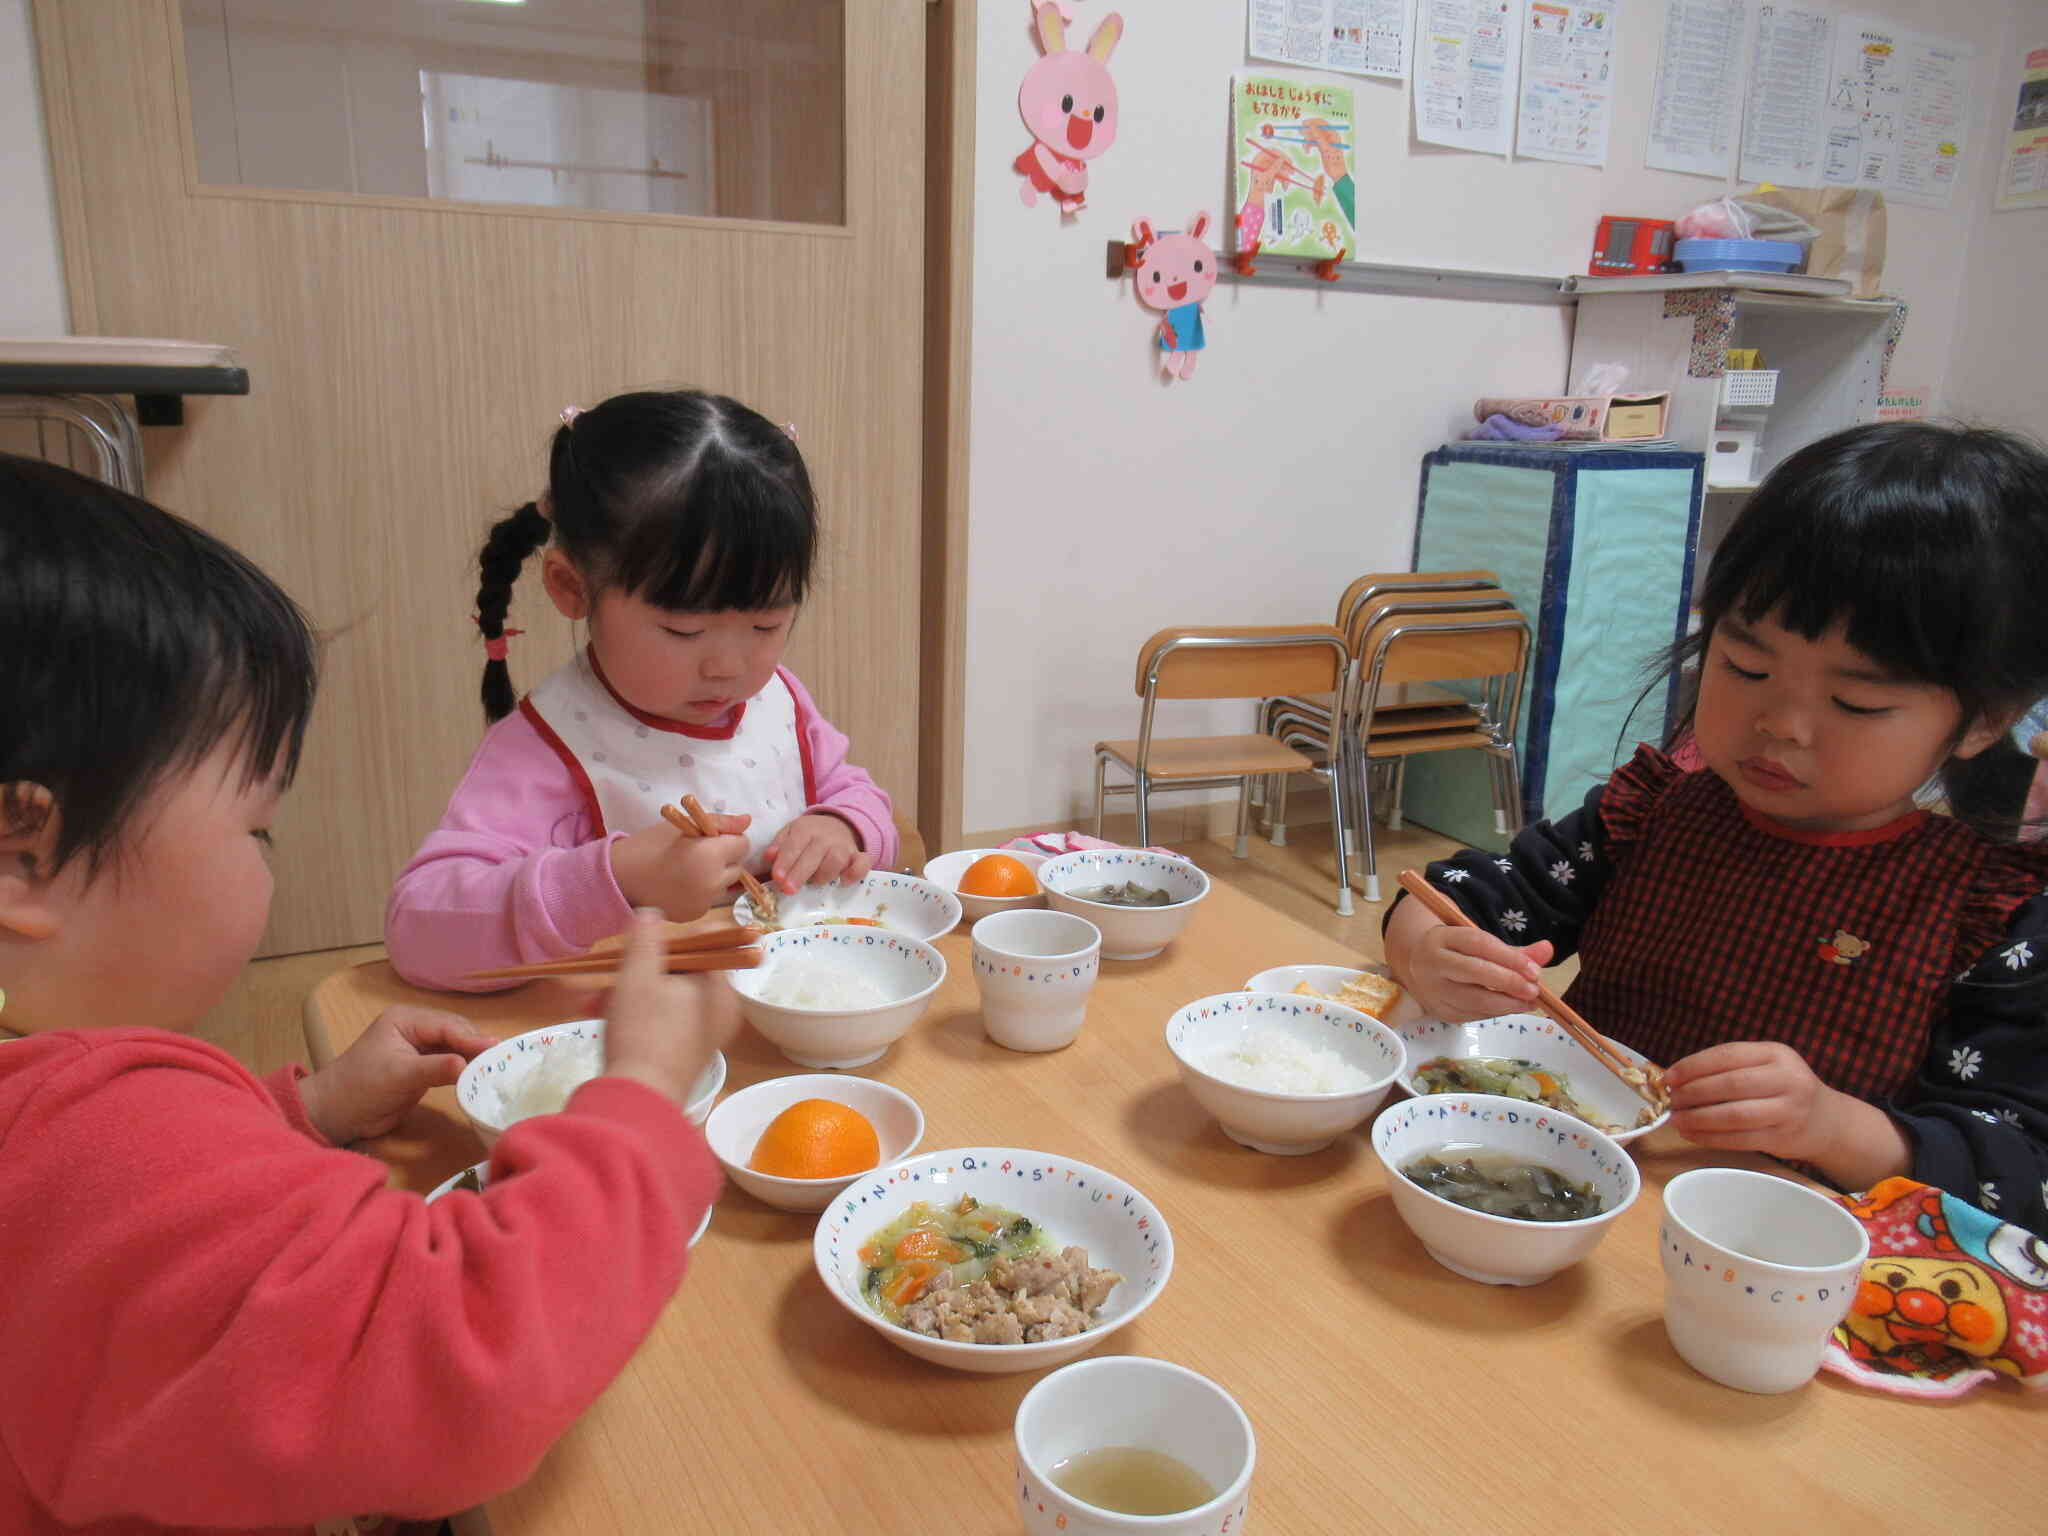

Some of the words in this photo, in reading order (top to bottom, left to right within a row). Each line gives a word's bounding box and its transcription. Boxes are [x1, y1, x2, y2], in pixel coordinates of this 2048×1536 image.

[1246, 82, 1284, 99] おはしを
[1288, 87, 1334, 106] じょうずに
[1252, 101, 1302, 119] もてるかな
[1354, 1021, 1364, 1034] D
[516, 1039, 525, 1052] V
[541, 1035, 554, 1049] W
[1459, 1102, 1470, 1113] B
[1481, 1111, 1491, 1122] C
[1507, 1111, 1520, 1124] D
[1535, 1116, 1548, 1130] E
[1557, 1132, 1568, 1145] F
[872, 1183, 887, 1200] N
[898, 1168, 910, 1181] O
[962, 1157, 977, 1171] Q
[1032, 1168, 1043, 1182] S
[1064, 1169, 1076, 1183] T
[1090, 1189, 1103, 1203] U
[1122, 1192, 1135, 1208] V
[1683, 1252, 1693, 1266] A
[1770, 1290, 1784, 1303] C
[1817, 1288, 1830, 1302] D
